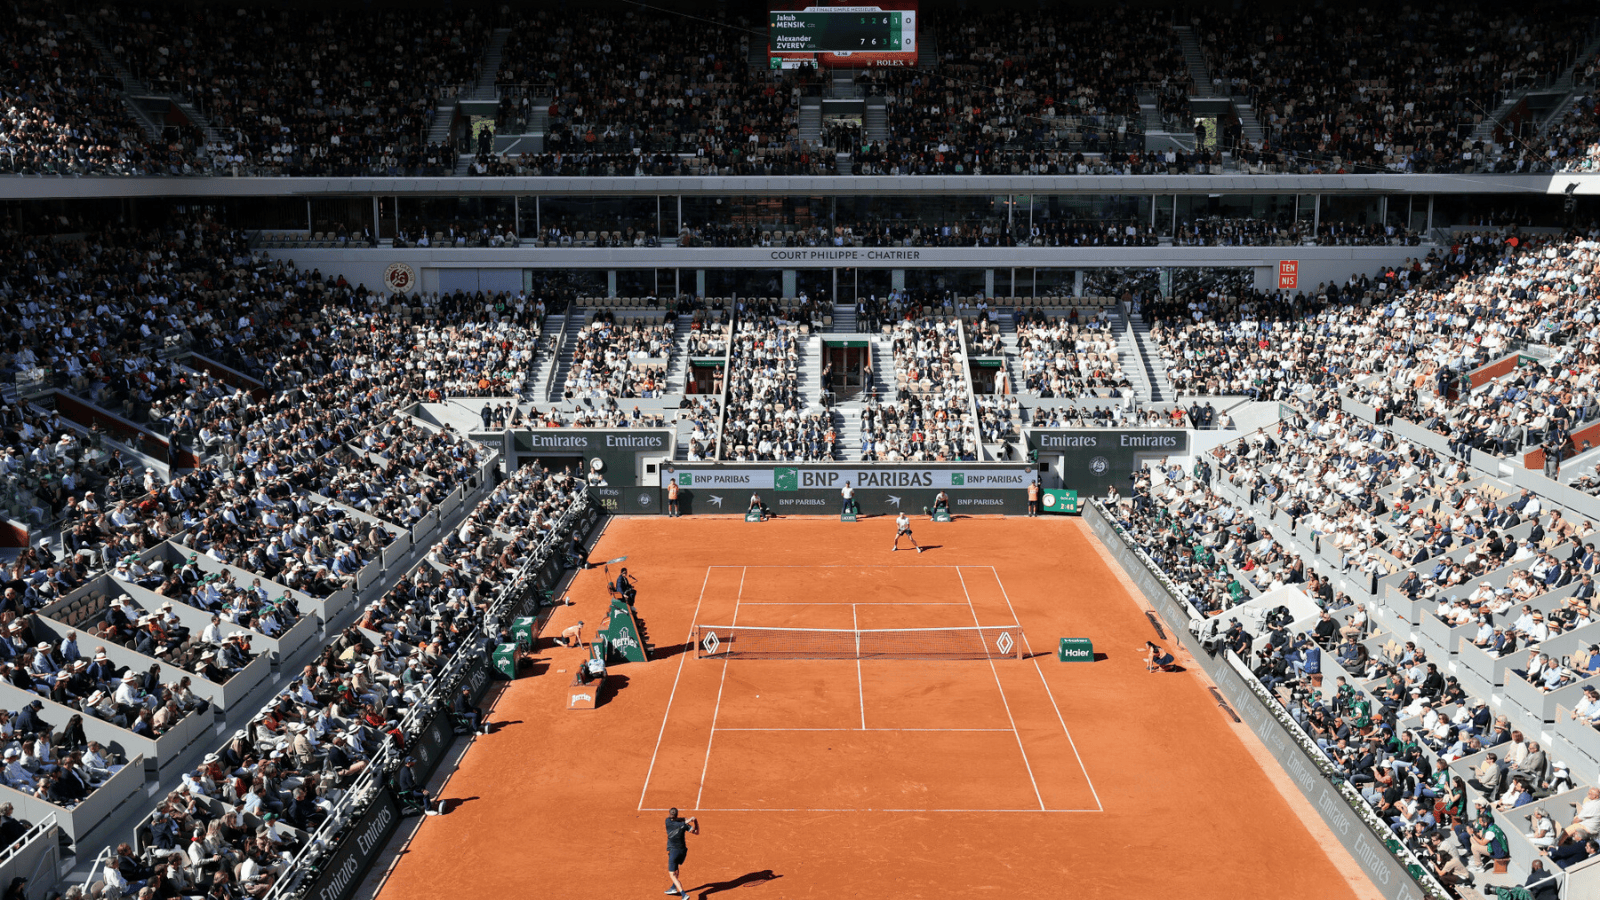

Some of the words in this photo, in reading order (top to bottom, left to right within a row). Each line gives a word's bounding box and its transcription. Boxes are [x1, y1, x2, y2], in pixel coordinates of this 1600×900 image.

[771, 251, 807, 260] COURT
[811, 251, 858, 260] PHILIPPE
[867, 251, 920, 260] CHATRIER
[1282, 264, 1295, 272] TEN
[532, 435, 588, 447] Emirates
[606, 435, 662, 447] Emirates
[1041, 434, 1097, 446] Emirates
[1120, 434, 1176, 446] Emirates
[803, 472, 839, 486] BNP
[858, 472, 932, 486] PARIBAS
[1286, 750, 1316, 792] Emirates
[1318, 788, 1350, 835] Emirates
[357, 805, 391, 856] Emirates
[1354, 833, 1391, 884] Emirates
